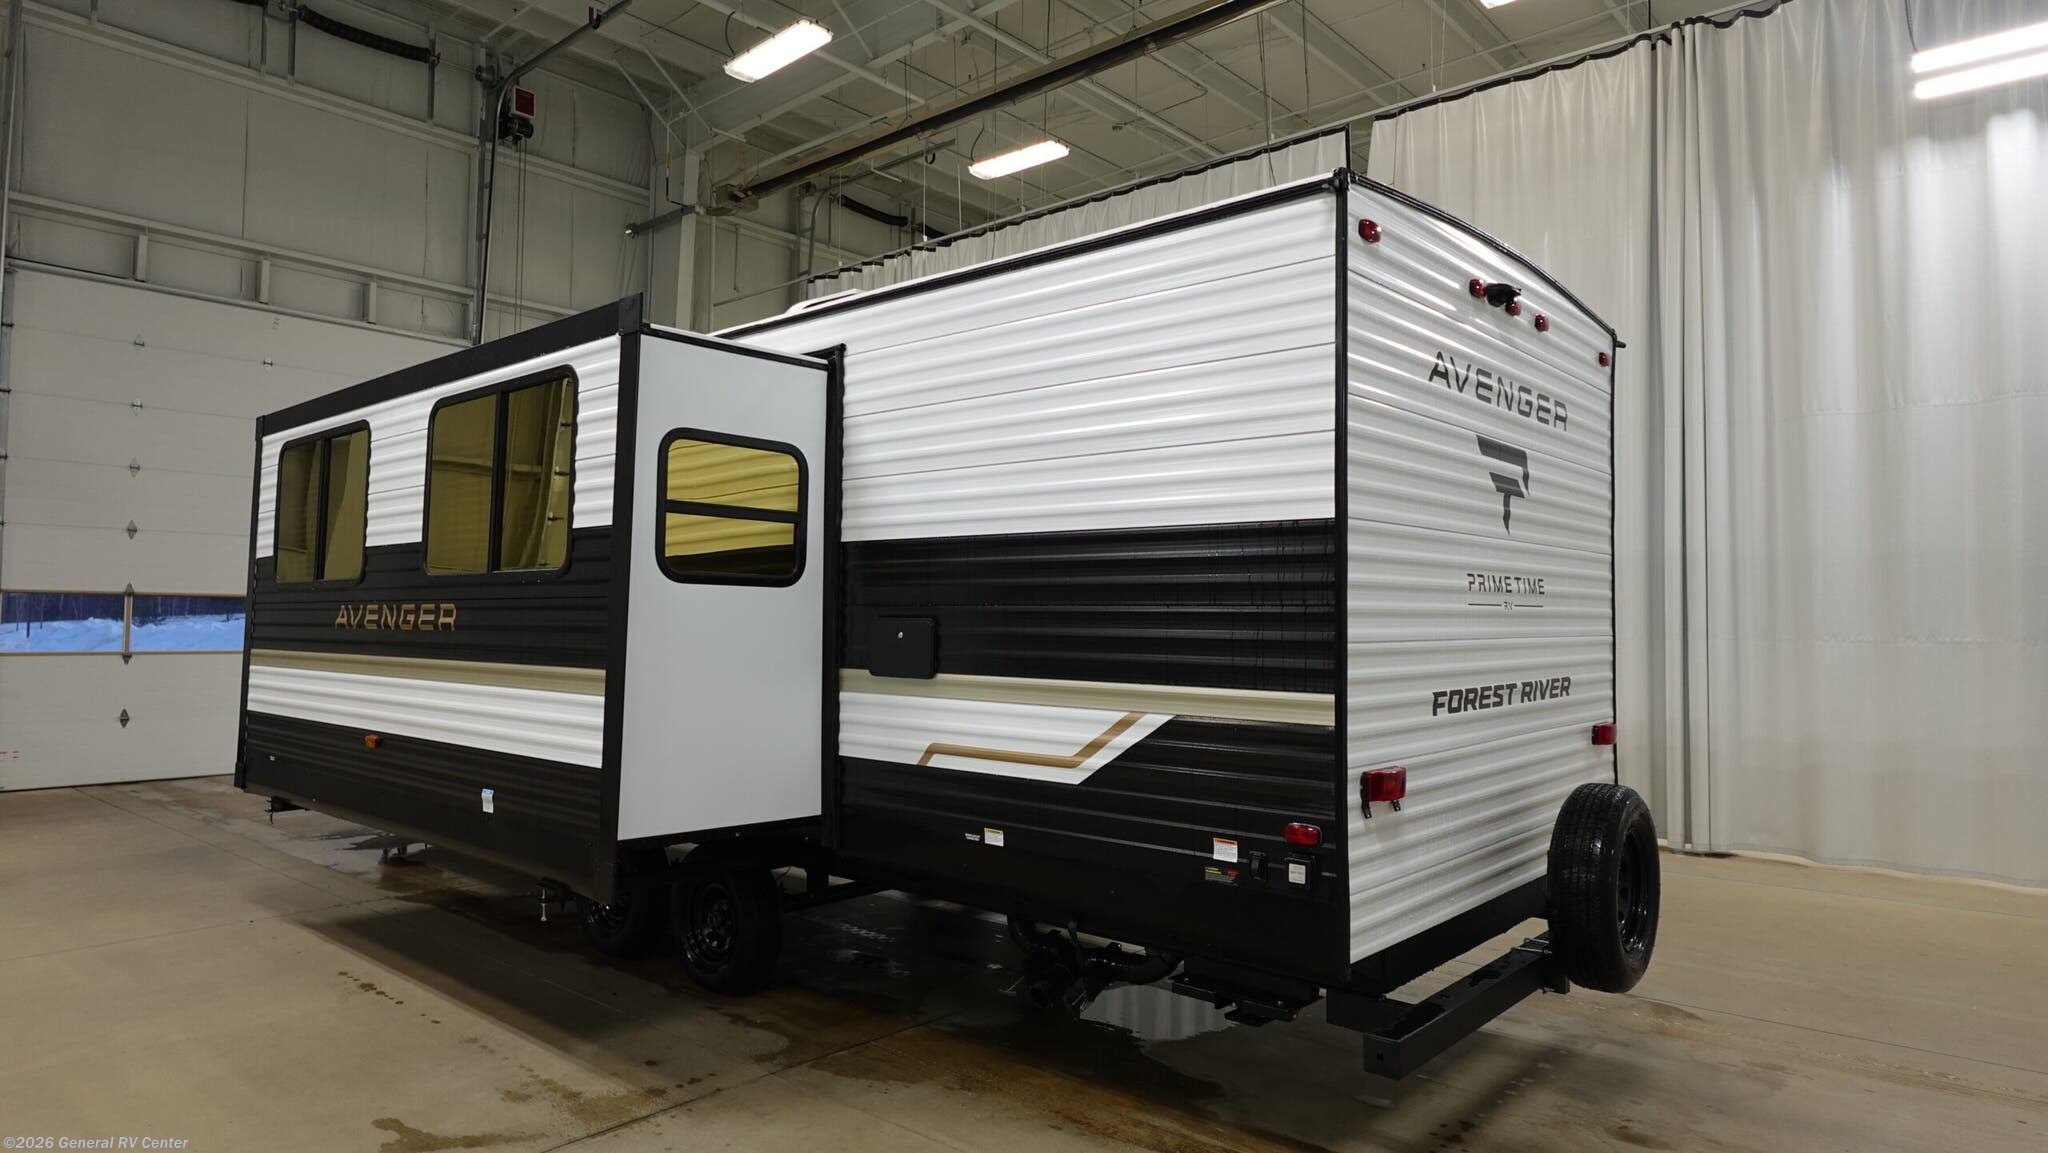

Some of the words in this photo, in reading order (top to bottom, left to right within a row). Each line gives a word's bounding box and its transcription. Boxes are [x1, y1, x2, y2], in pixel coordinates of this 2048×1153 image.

[1428, 351, 1568, 432] AVENGER
[335, 603, 457, 631] AVENGER
[1432, 683, 1517, 717] FOREST
[1520, 676, 1571, 703] RIVER
